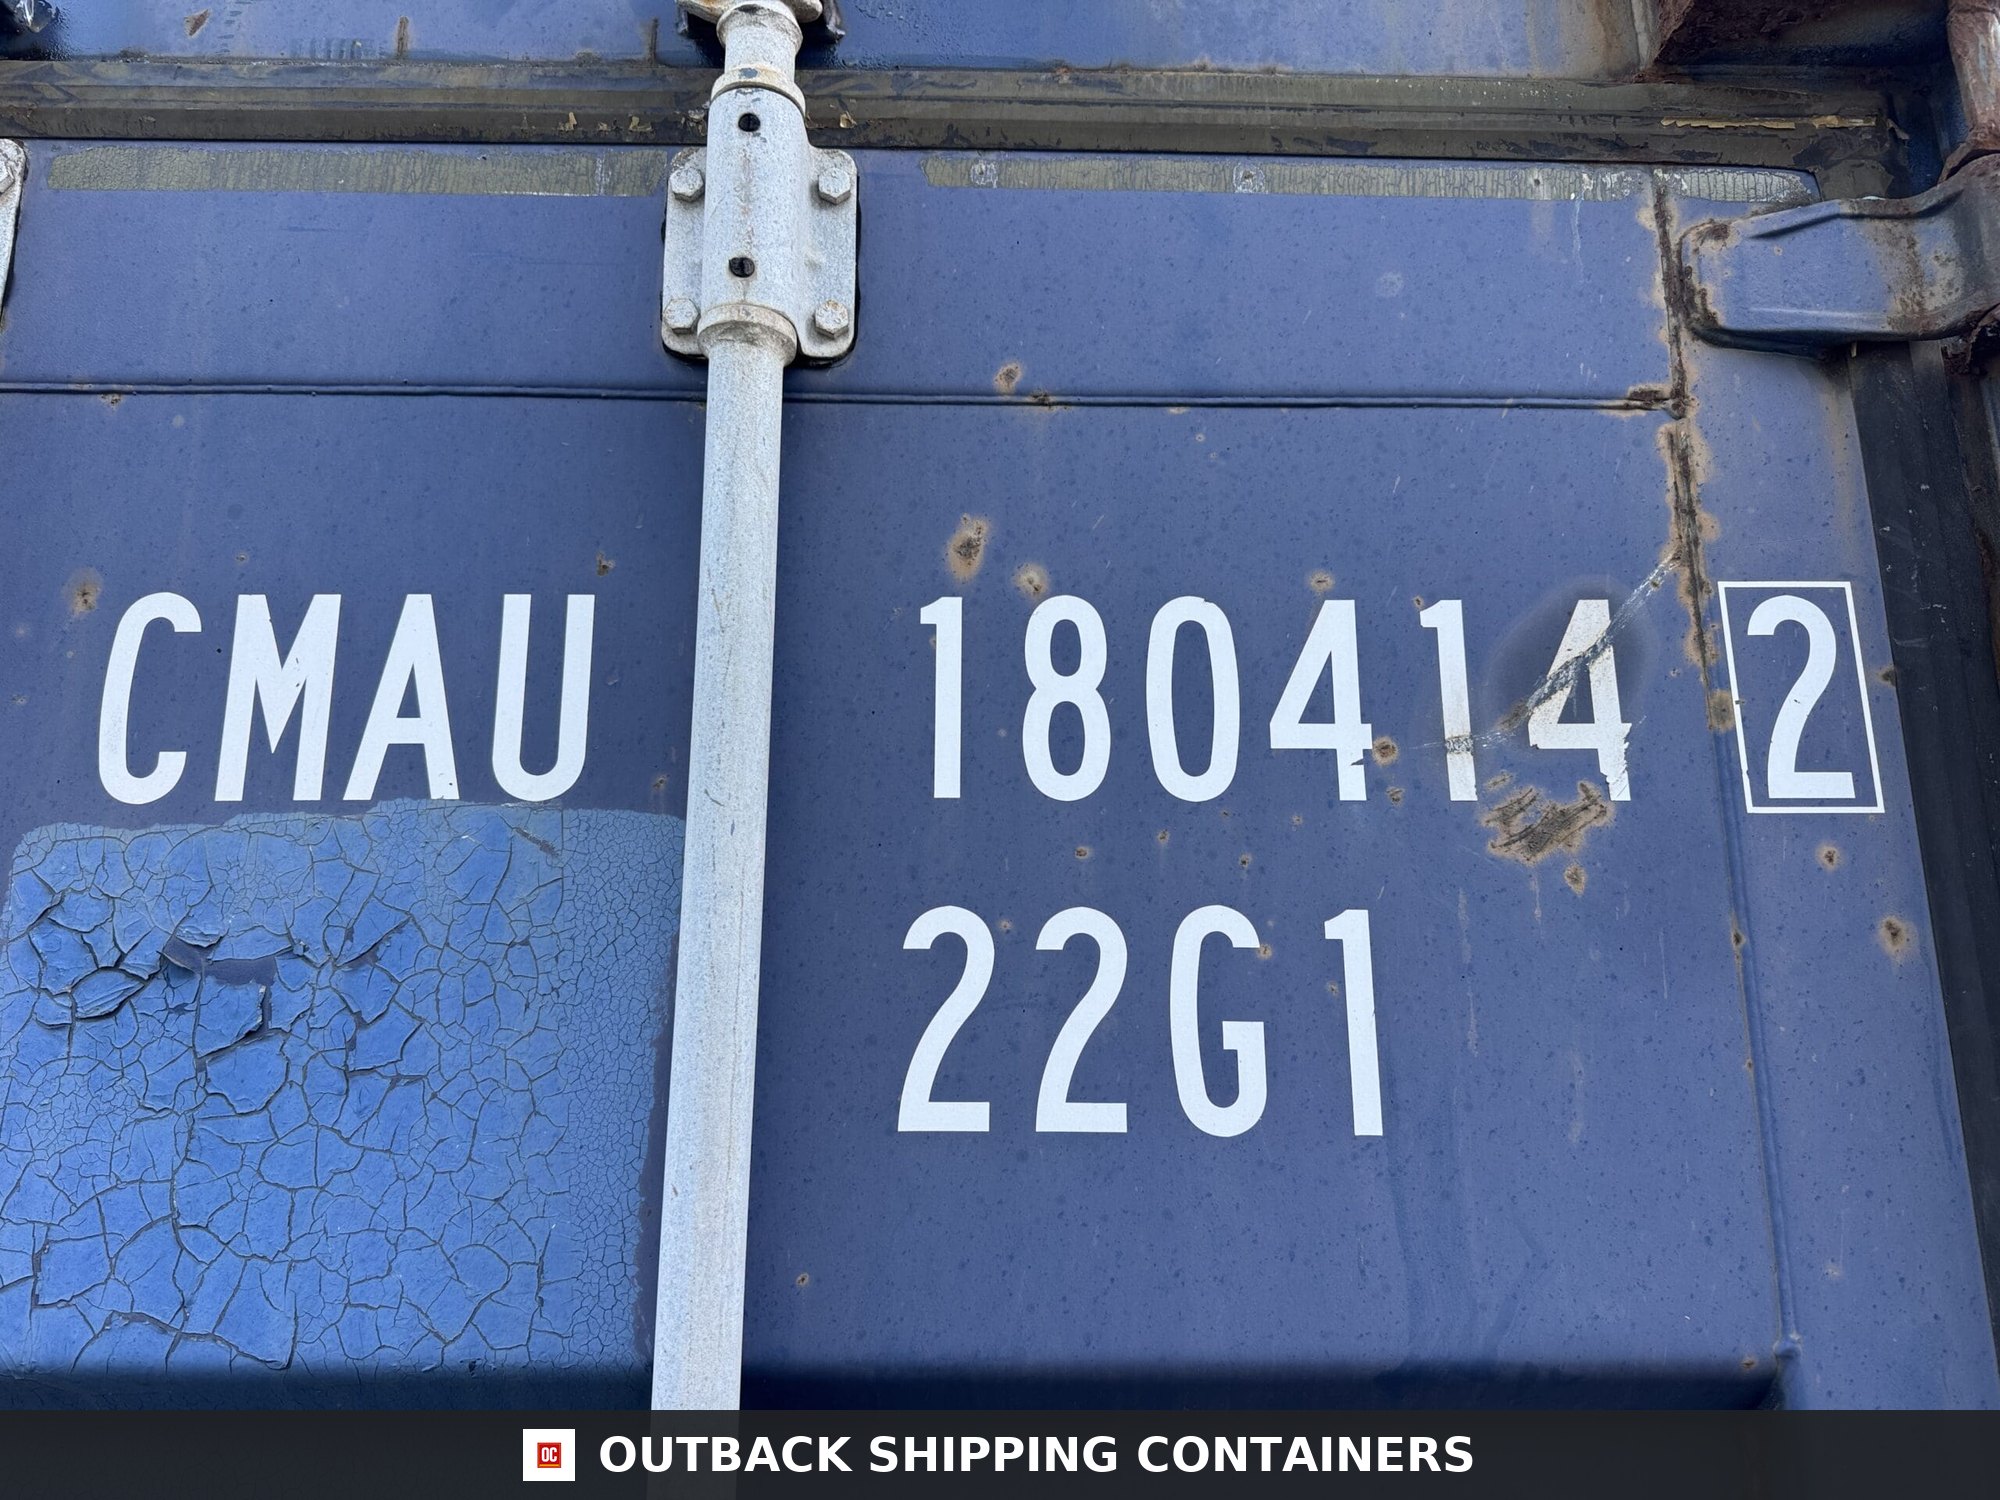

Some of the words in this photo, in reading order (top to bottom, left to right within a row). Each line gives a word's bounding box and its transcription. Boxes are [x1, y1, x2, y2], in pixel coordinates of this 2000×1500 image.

[98, 592, 595, 804] CMAU
[920, 595, 1633, 803] 180414
[1746, 594, 1856, 800] 2
[897, 904, 1384, 1138] 22G1
